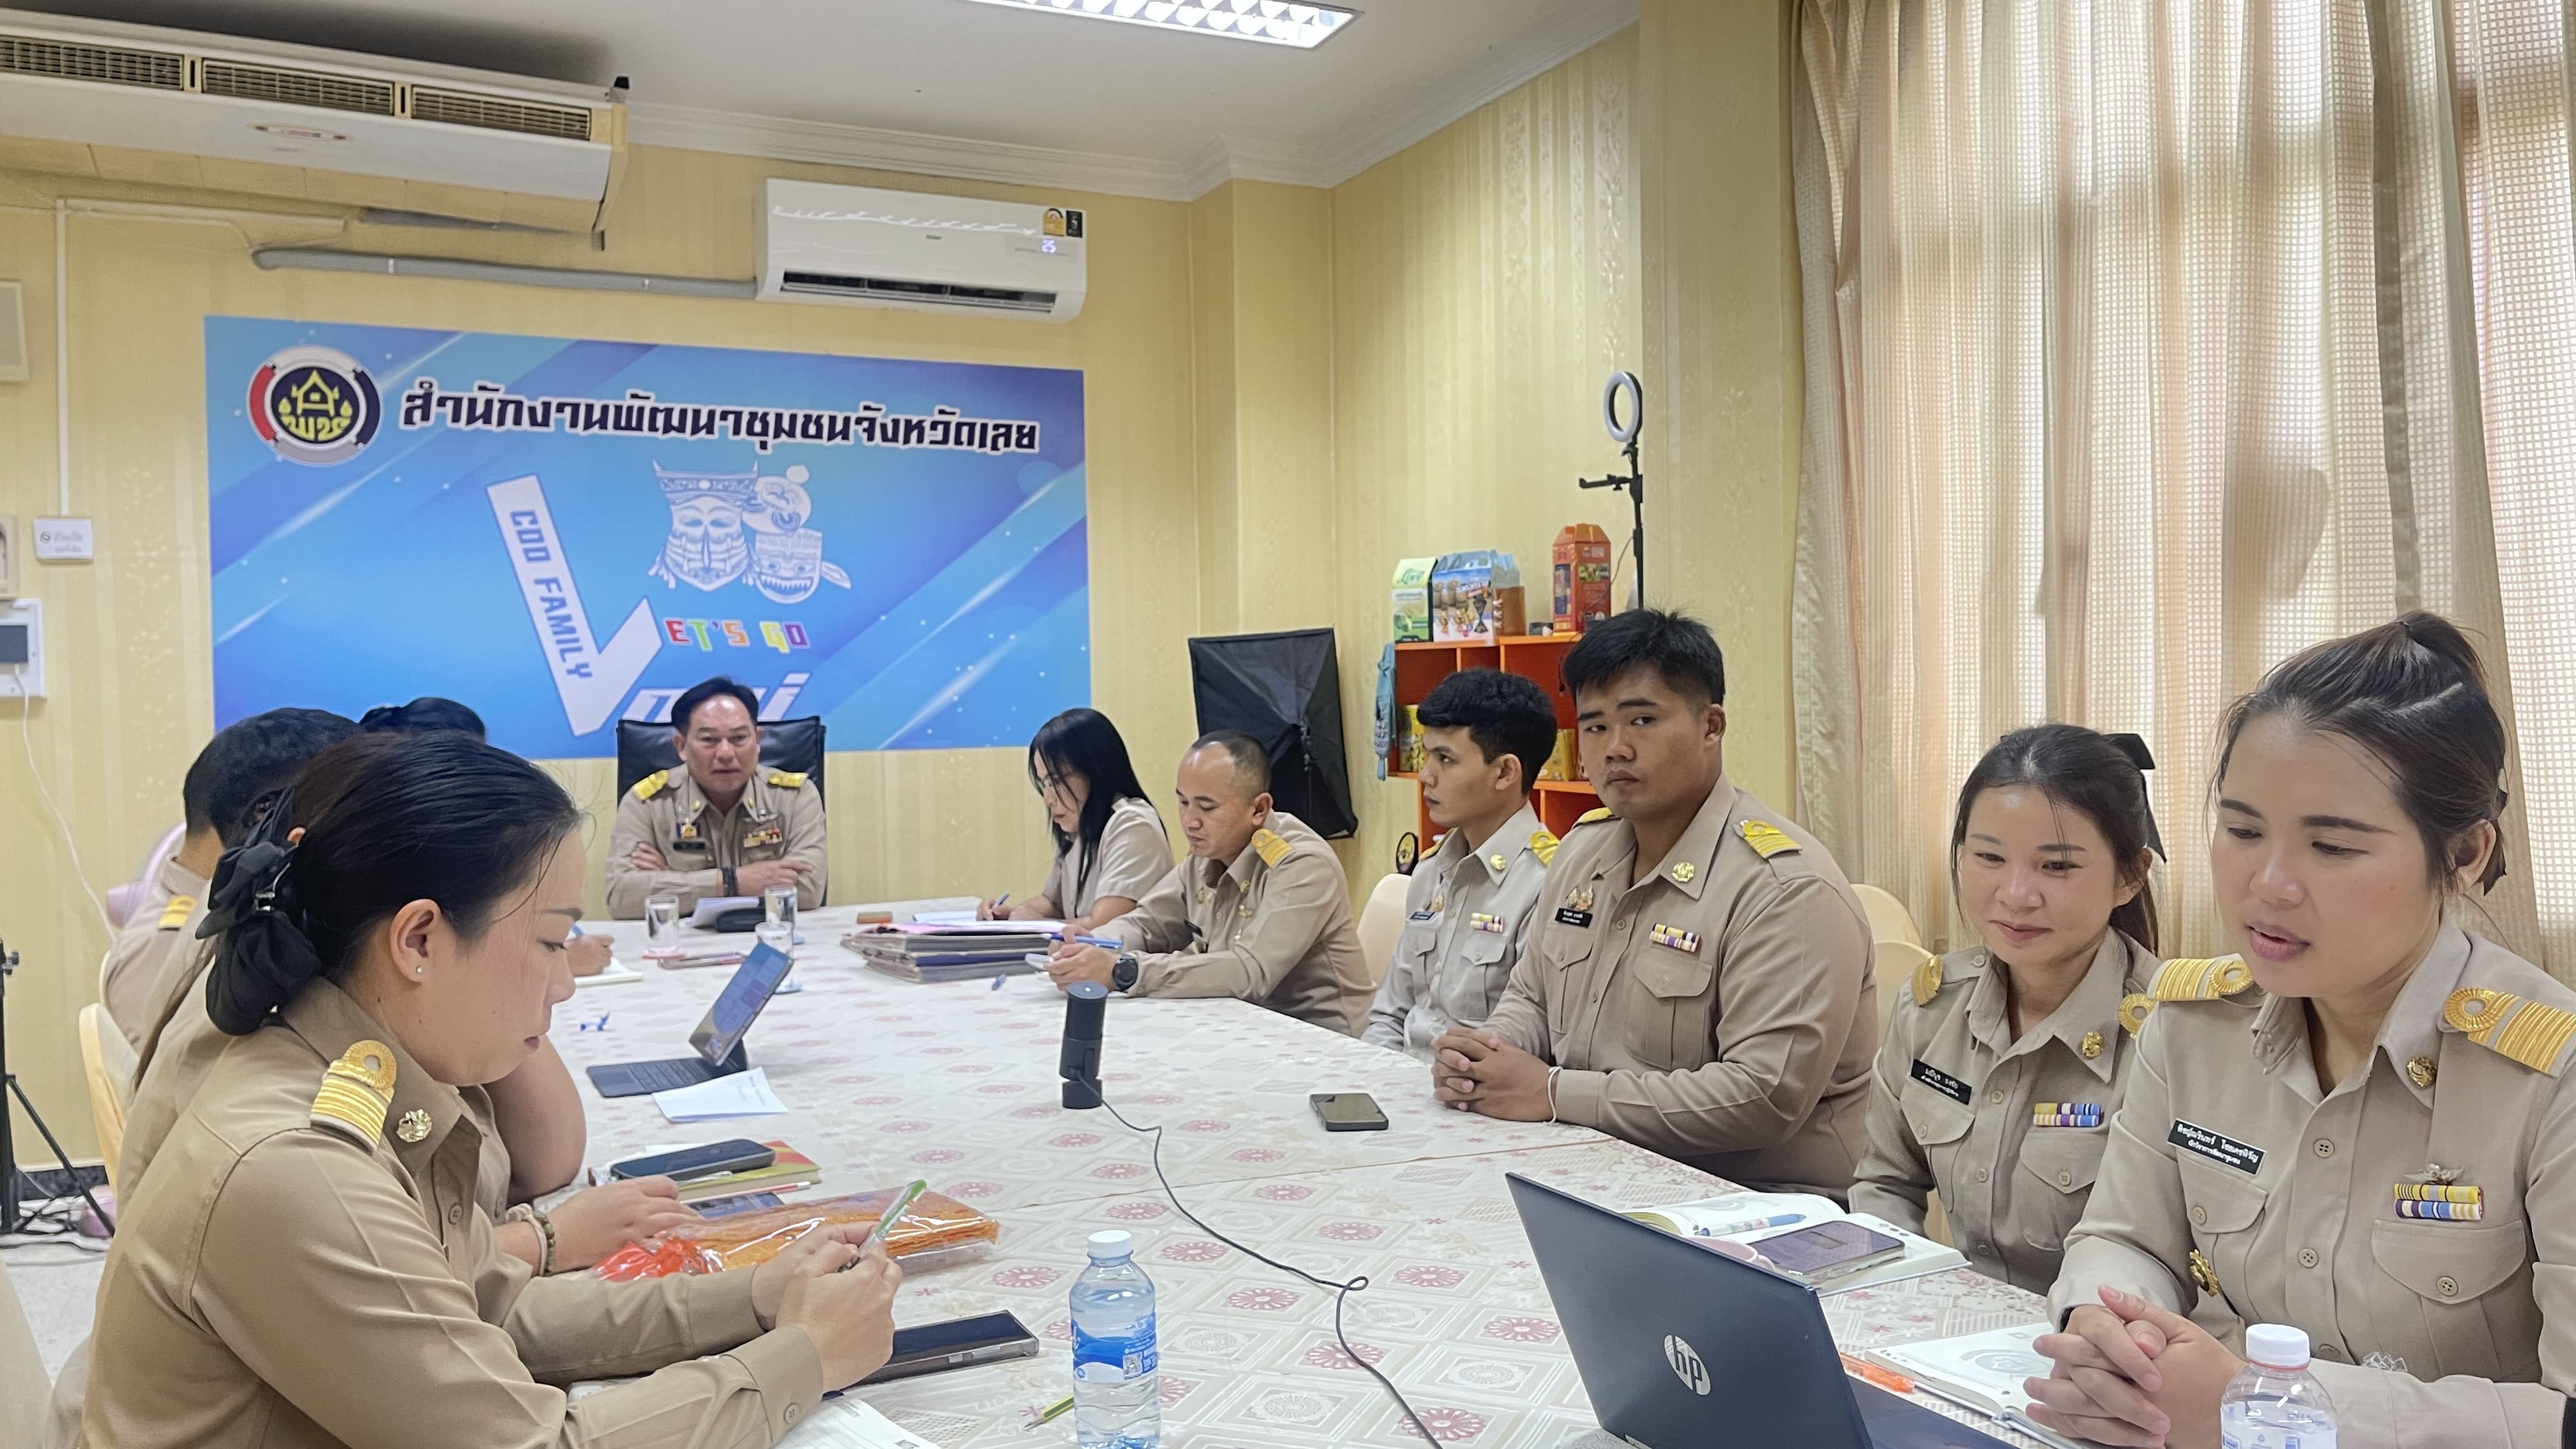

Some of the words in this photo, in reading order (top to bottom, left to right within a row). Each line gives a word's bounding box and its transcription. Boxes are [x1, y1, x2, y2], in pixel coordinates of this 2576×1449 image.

[402, 381, 1037, 451] สำนักงานพัฒนาชุมชนจังหวัดเลย
[533, 577, 593, 680] FAMILY
[1667, 1334, 1708, 1396] hp
